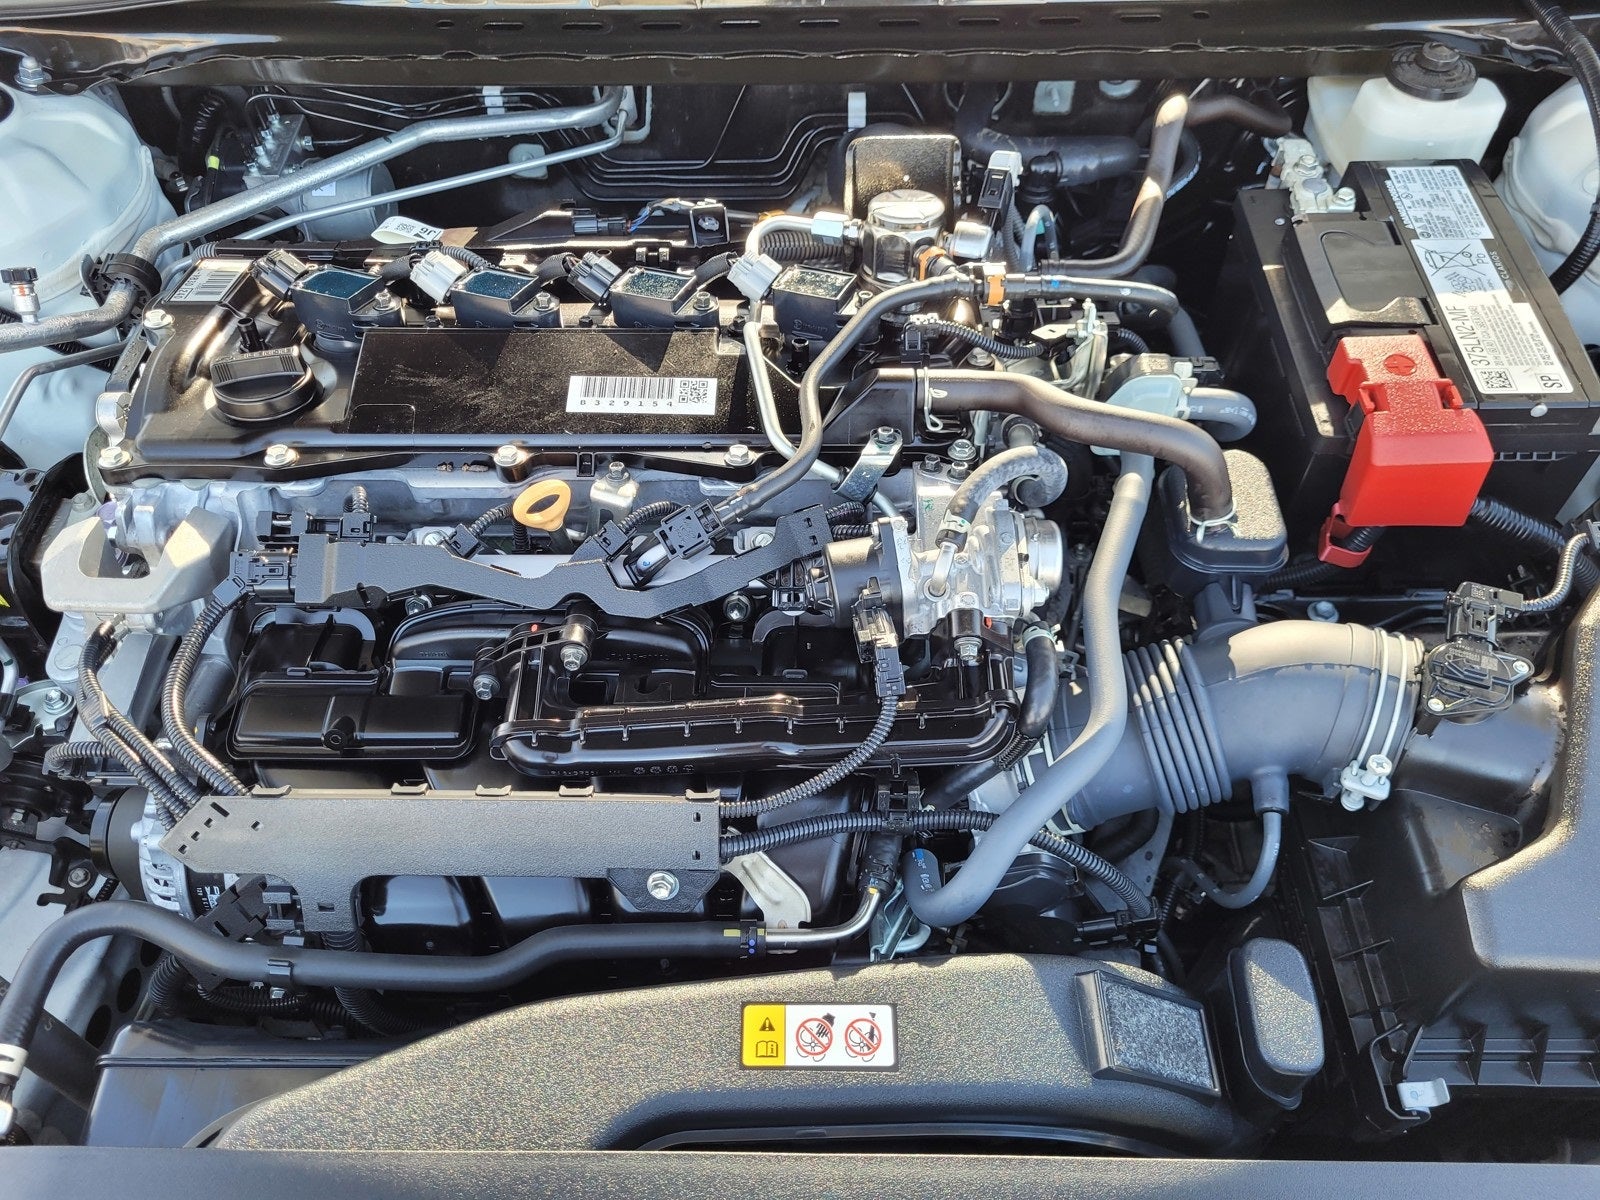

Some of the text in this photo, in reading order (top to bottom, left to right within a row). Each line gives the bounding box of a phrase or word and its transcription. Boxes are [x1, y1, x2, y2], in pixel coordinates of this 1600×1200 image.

[1490, 251, 1509, 280] CLARIOS
[1445, 305, 1490, 366] 375LN2-MF
[1540, 375, 1563, 389] SP
[579, 399, 673, 407] B329154
